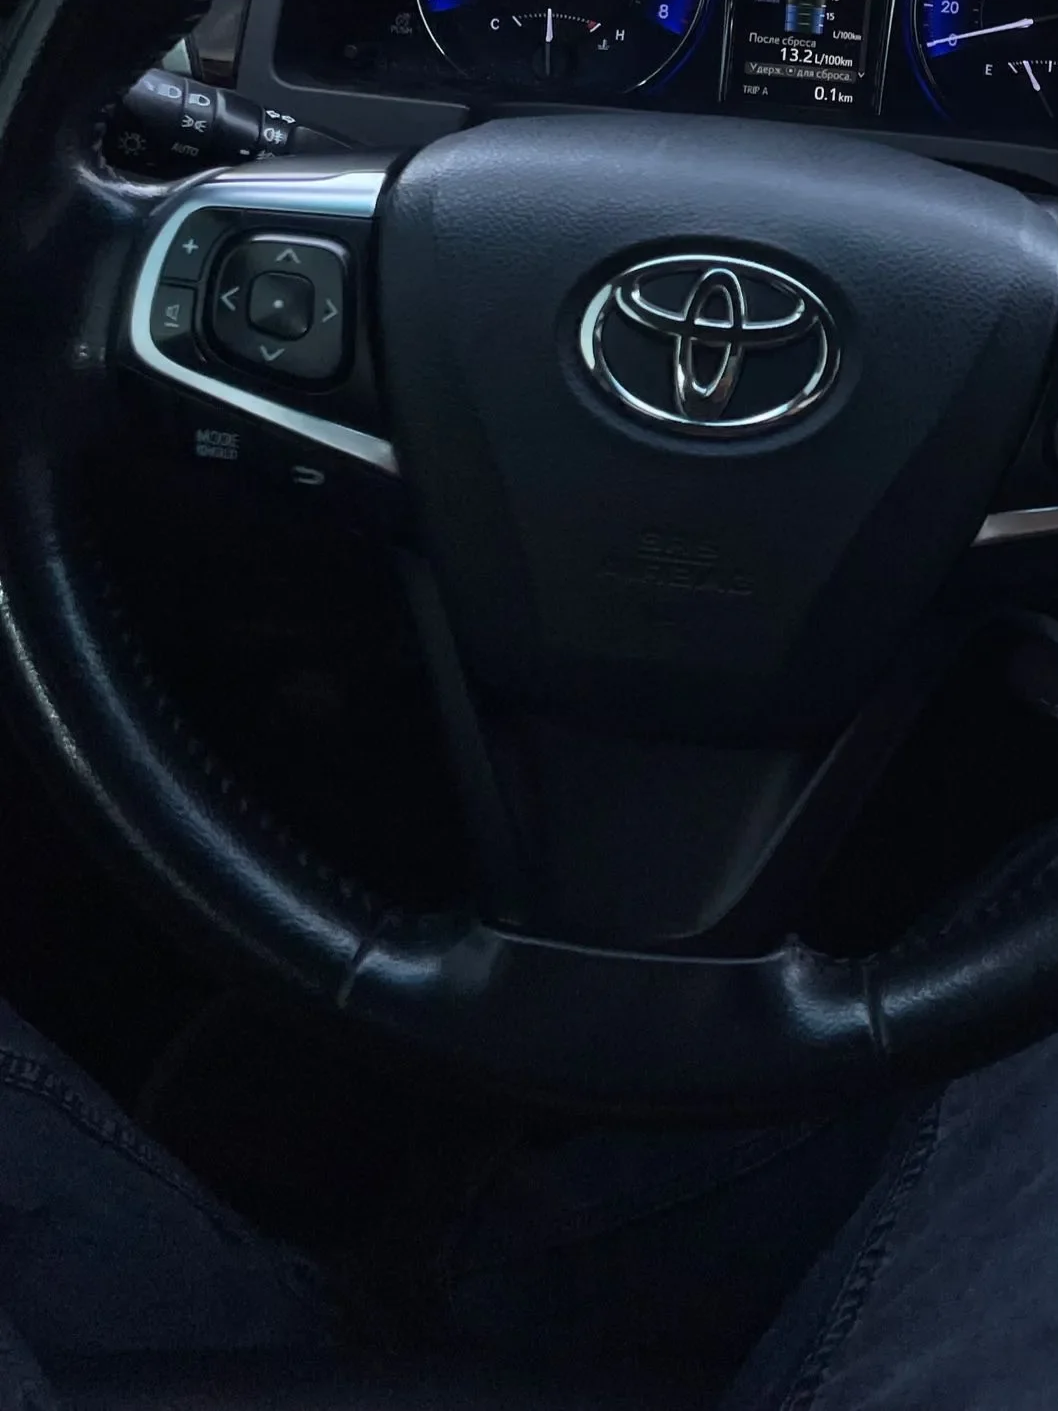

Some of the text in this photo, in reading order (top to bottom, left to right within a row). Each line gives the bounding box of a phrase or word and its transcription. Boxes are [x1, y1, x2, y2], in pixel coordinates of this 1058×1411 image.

[658, 3, 669, 19] 8
[940, 0, 960, 15] 20
[826, 11, 836, 22] 15
[489, 18, 500, 31] C
[615, 29, 626, 41] H
[748, 31, 780, 46] После
[780, 47, 853, 68] 13.2 L/100km
[984, 63, 993, 76] E
[814, 85, 854, 104] 0.1 km
